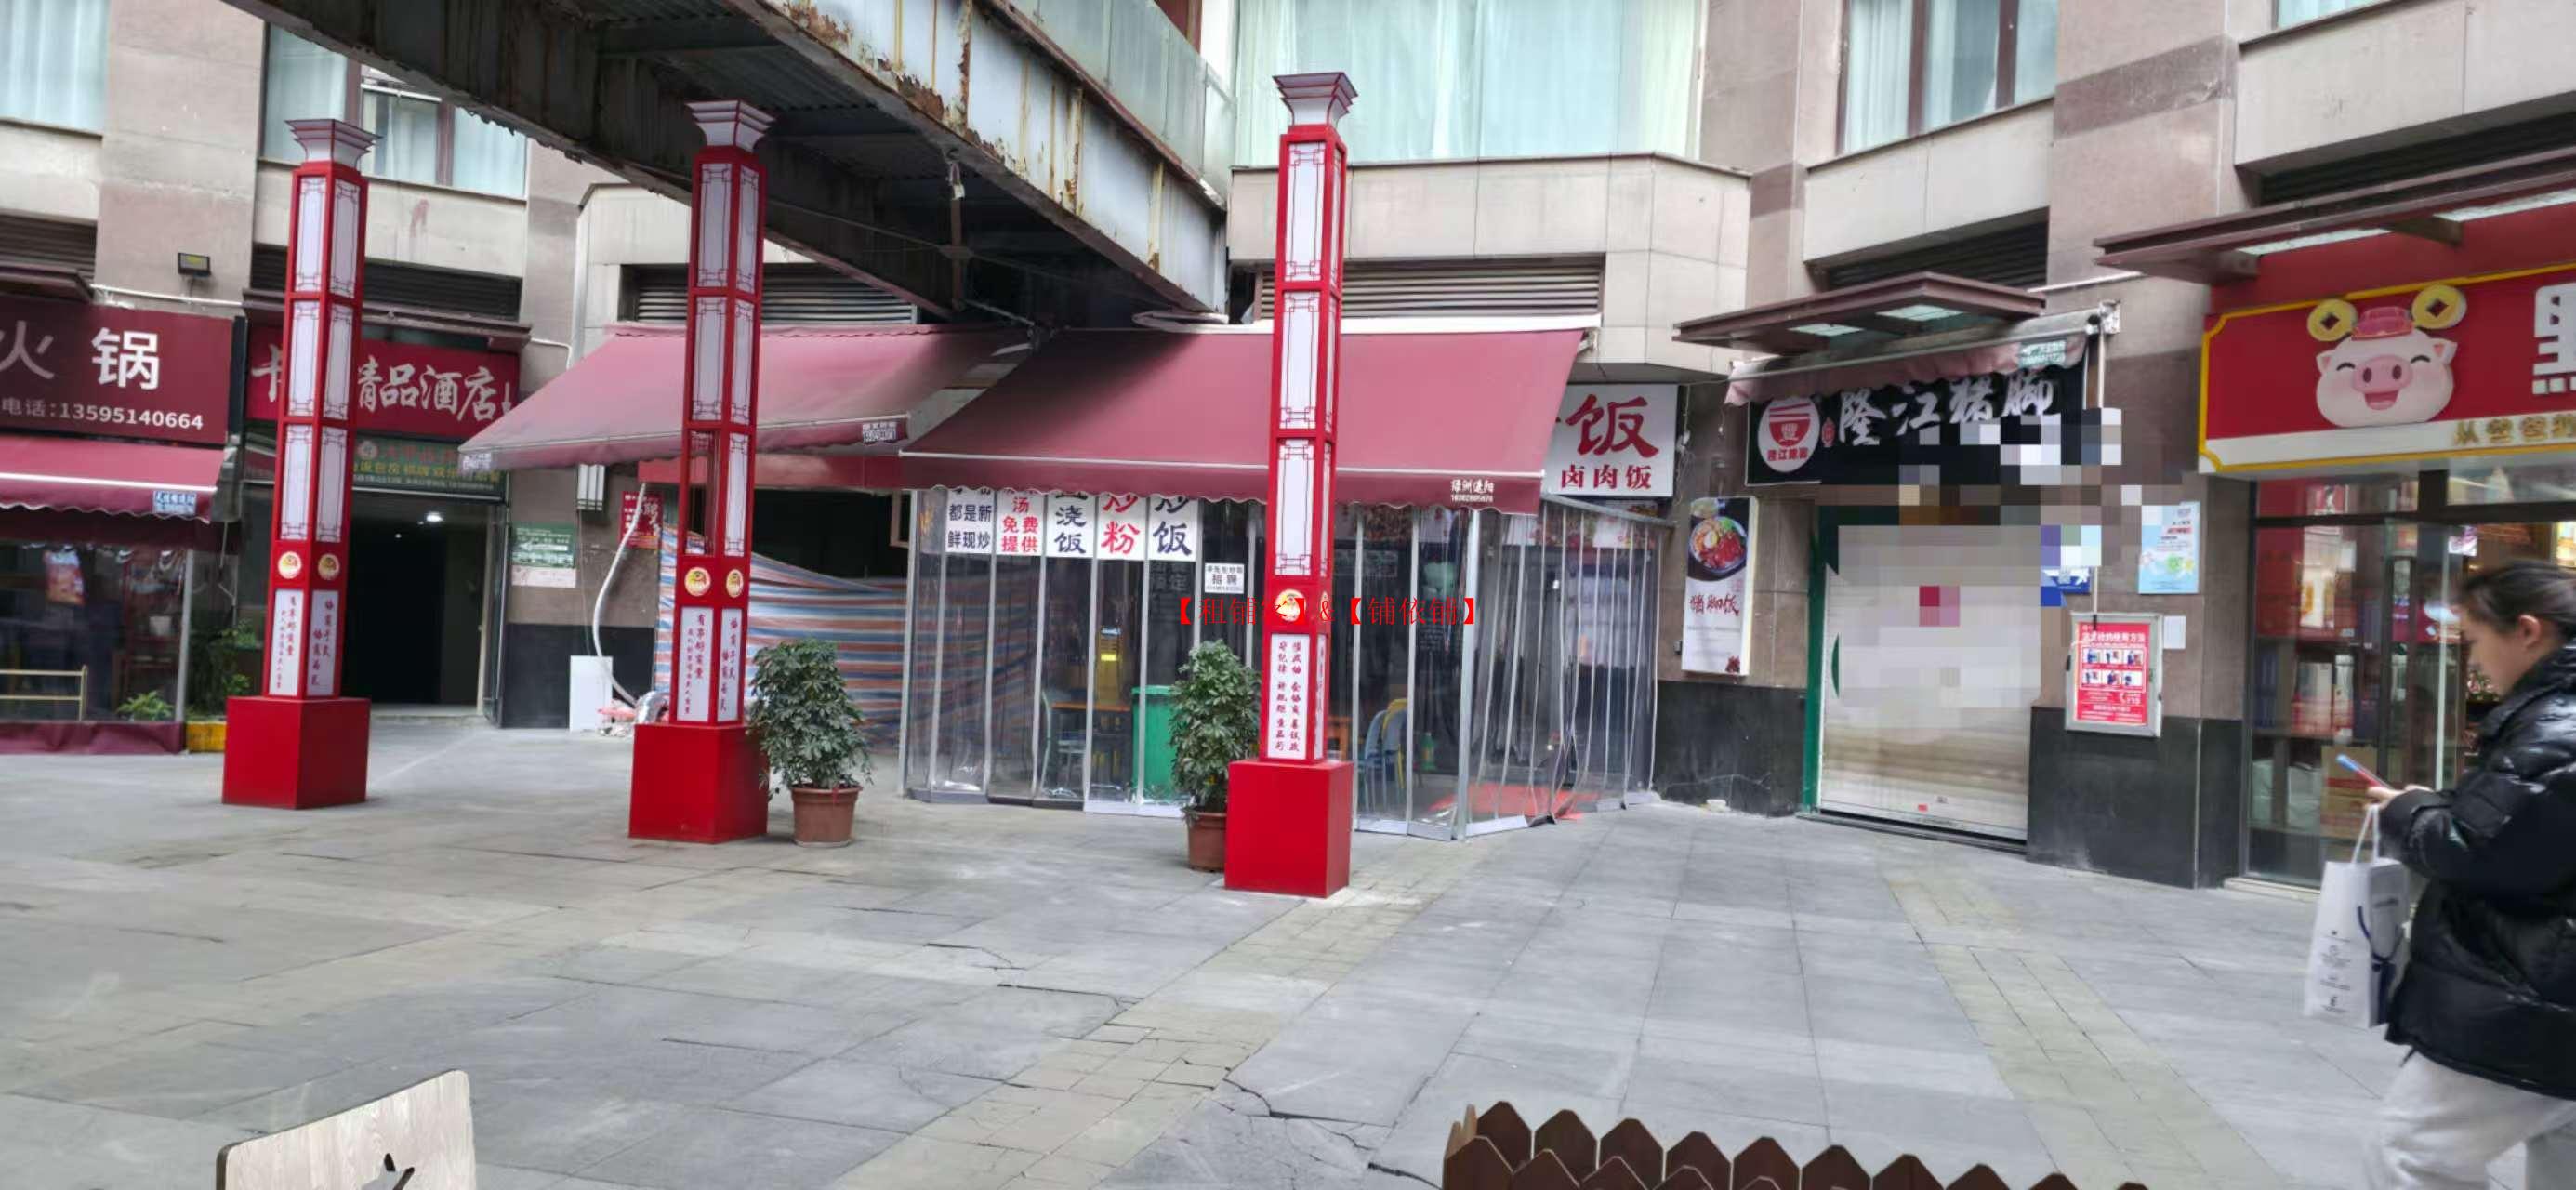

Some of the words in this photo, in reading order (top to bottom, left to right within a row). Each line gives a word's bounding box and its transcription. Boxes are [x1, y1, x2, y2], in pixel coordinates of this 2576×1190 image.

[0, 320, 160, 390] 火锅
[1561, 464, 1651, 490] 卤肉饭
[949, 503, 993, 522] 都是新
[1012, 496, 1029, 513] 汤
[1002, 515, 1039, 534] 免费
[1054, 492, 1088, 555] 浇饭
[947, 530, 990, 549] 鲜现炒
[1001, 536, 1038, 553] 提供
